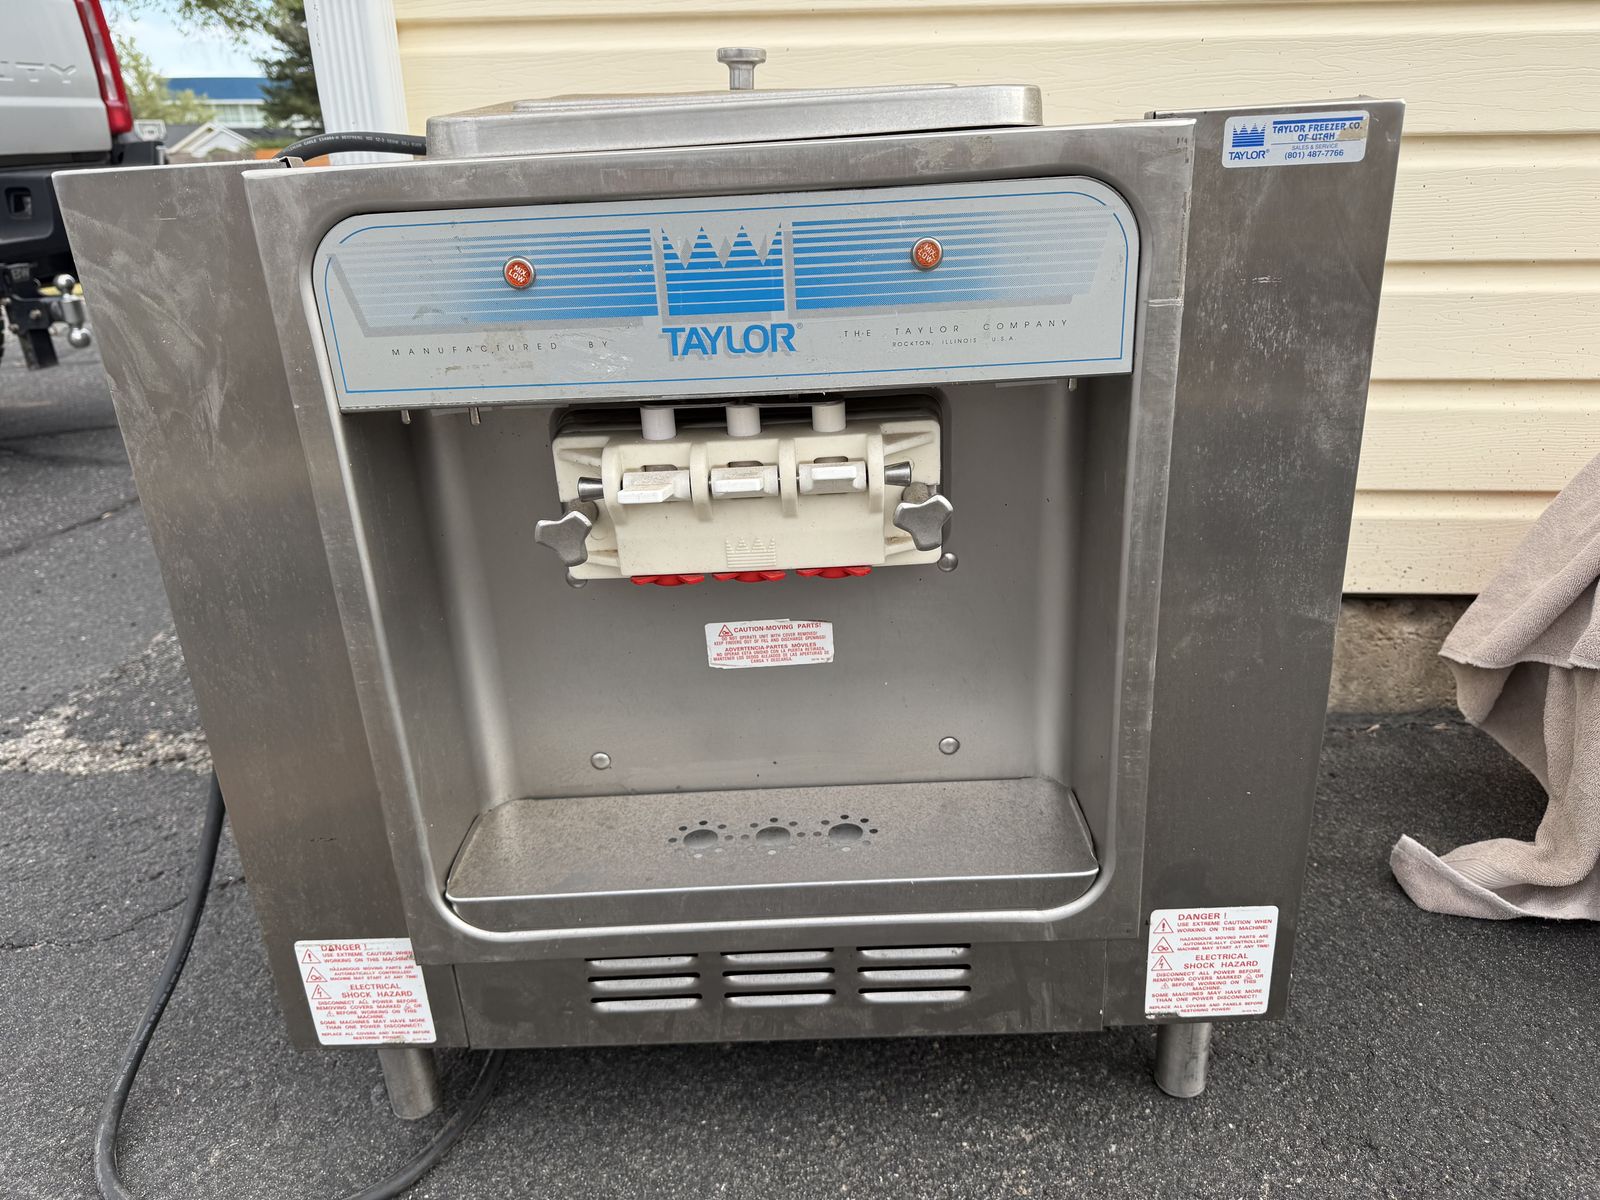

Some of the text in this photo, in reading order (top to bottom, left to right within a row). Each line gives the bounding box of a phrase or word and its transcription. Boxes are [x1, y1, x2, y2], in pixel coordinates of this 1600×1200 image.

[1273, 126, 1305, 134] TAYLOR
[1309, 123, 1346, 132] FREEZER
[1312, 132, 1335, 140] UTAH
[1285, 150, 1344, 160] (801) 487-7766
[509, 269, 525, 282] LOW
[514, 265, 527, 277] MIX
[895, 325, 959, 336] TAYLOR
[983, 320, 1067, 331] COMPANY
[392, 340, 607, 356] MANUFACTURED BY
